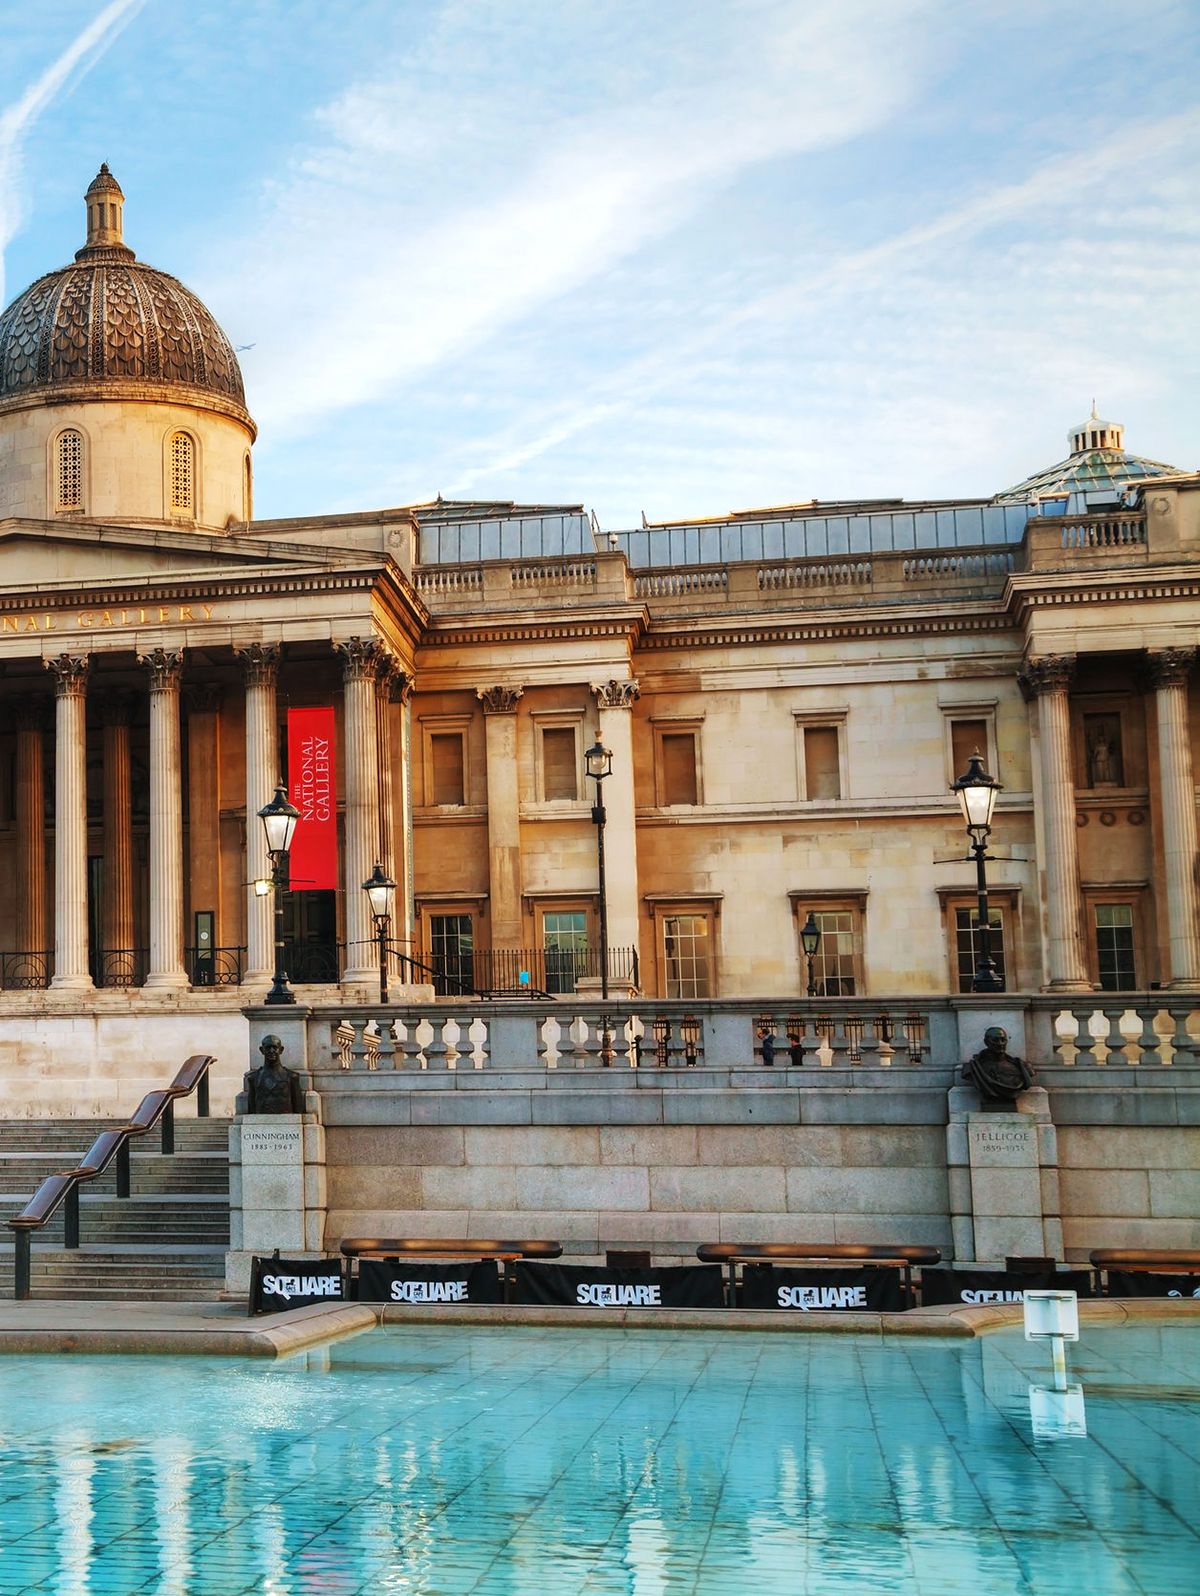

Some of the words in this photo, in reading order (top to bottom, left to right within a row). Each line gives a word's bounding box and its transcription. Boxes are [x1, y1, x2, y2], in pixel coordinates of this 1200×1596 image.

[77, 604, 216, 628] GALLERY
[302, 736, 314, 821] NATIONAL
[315, 736, 330, 821] GALLERY
[976, 1133, 1029, 1141] JELLICOE
[263, 1275, 341, 1300] SQUARE
[391, 1280, 469, 1304] SQUARE
[576, 1283, 661, 1307] SQUARE
[777, 1286, 867, 1311] SQUARE
[960, 1289, 1024, 1304] SQU
